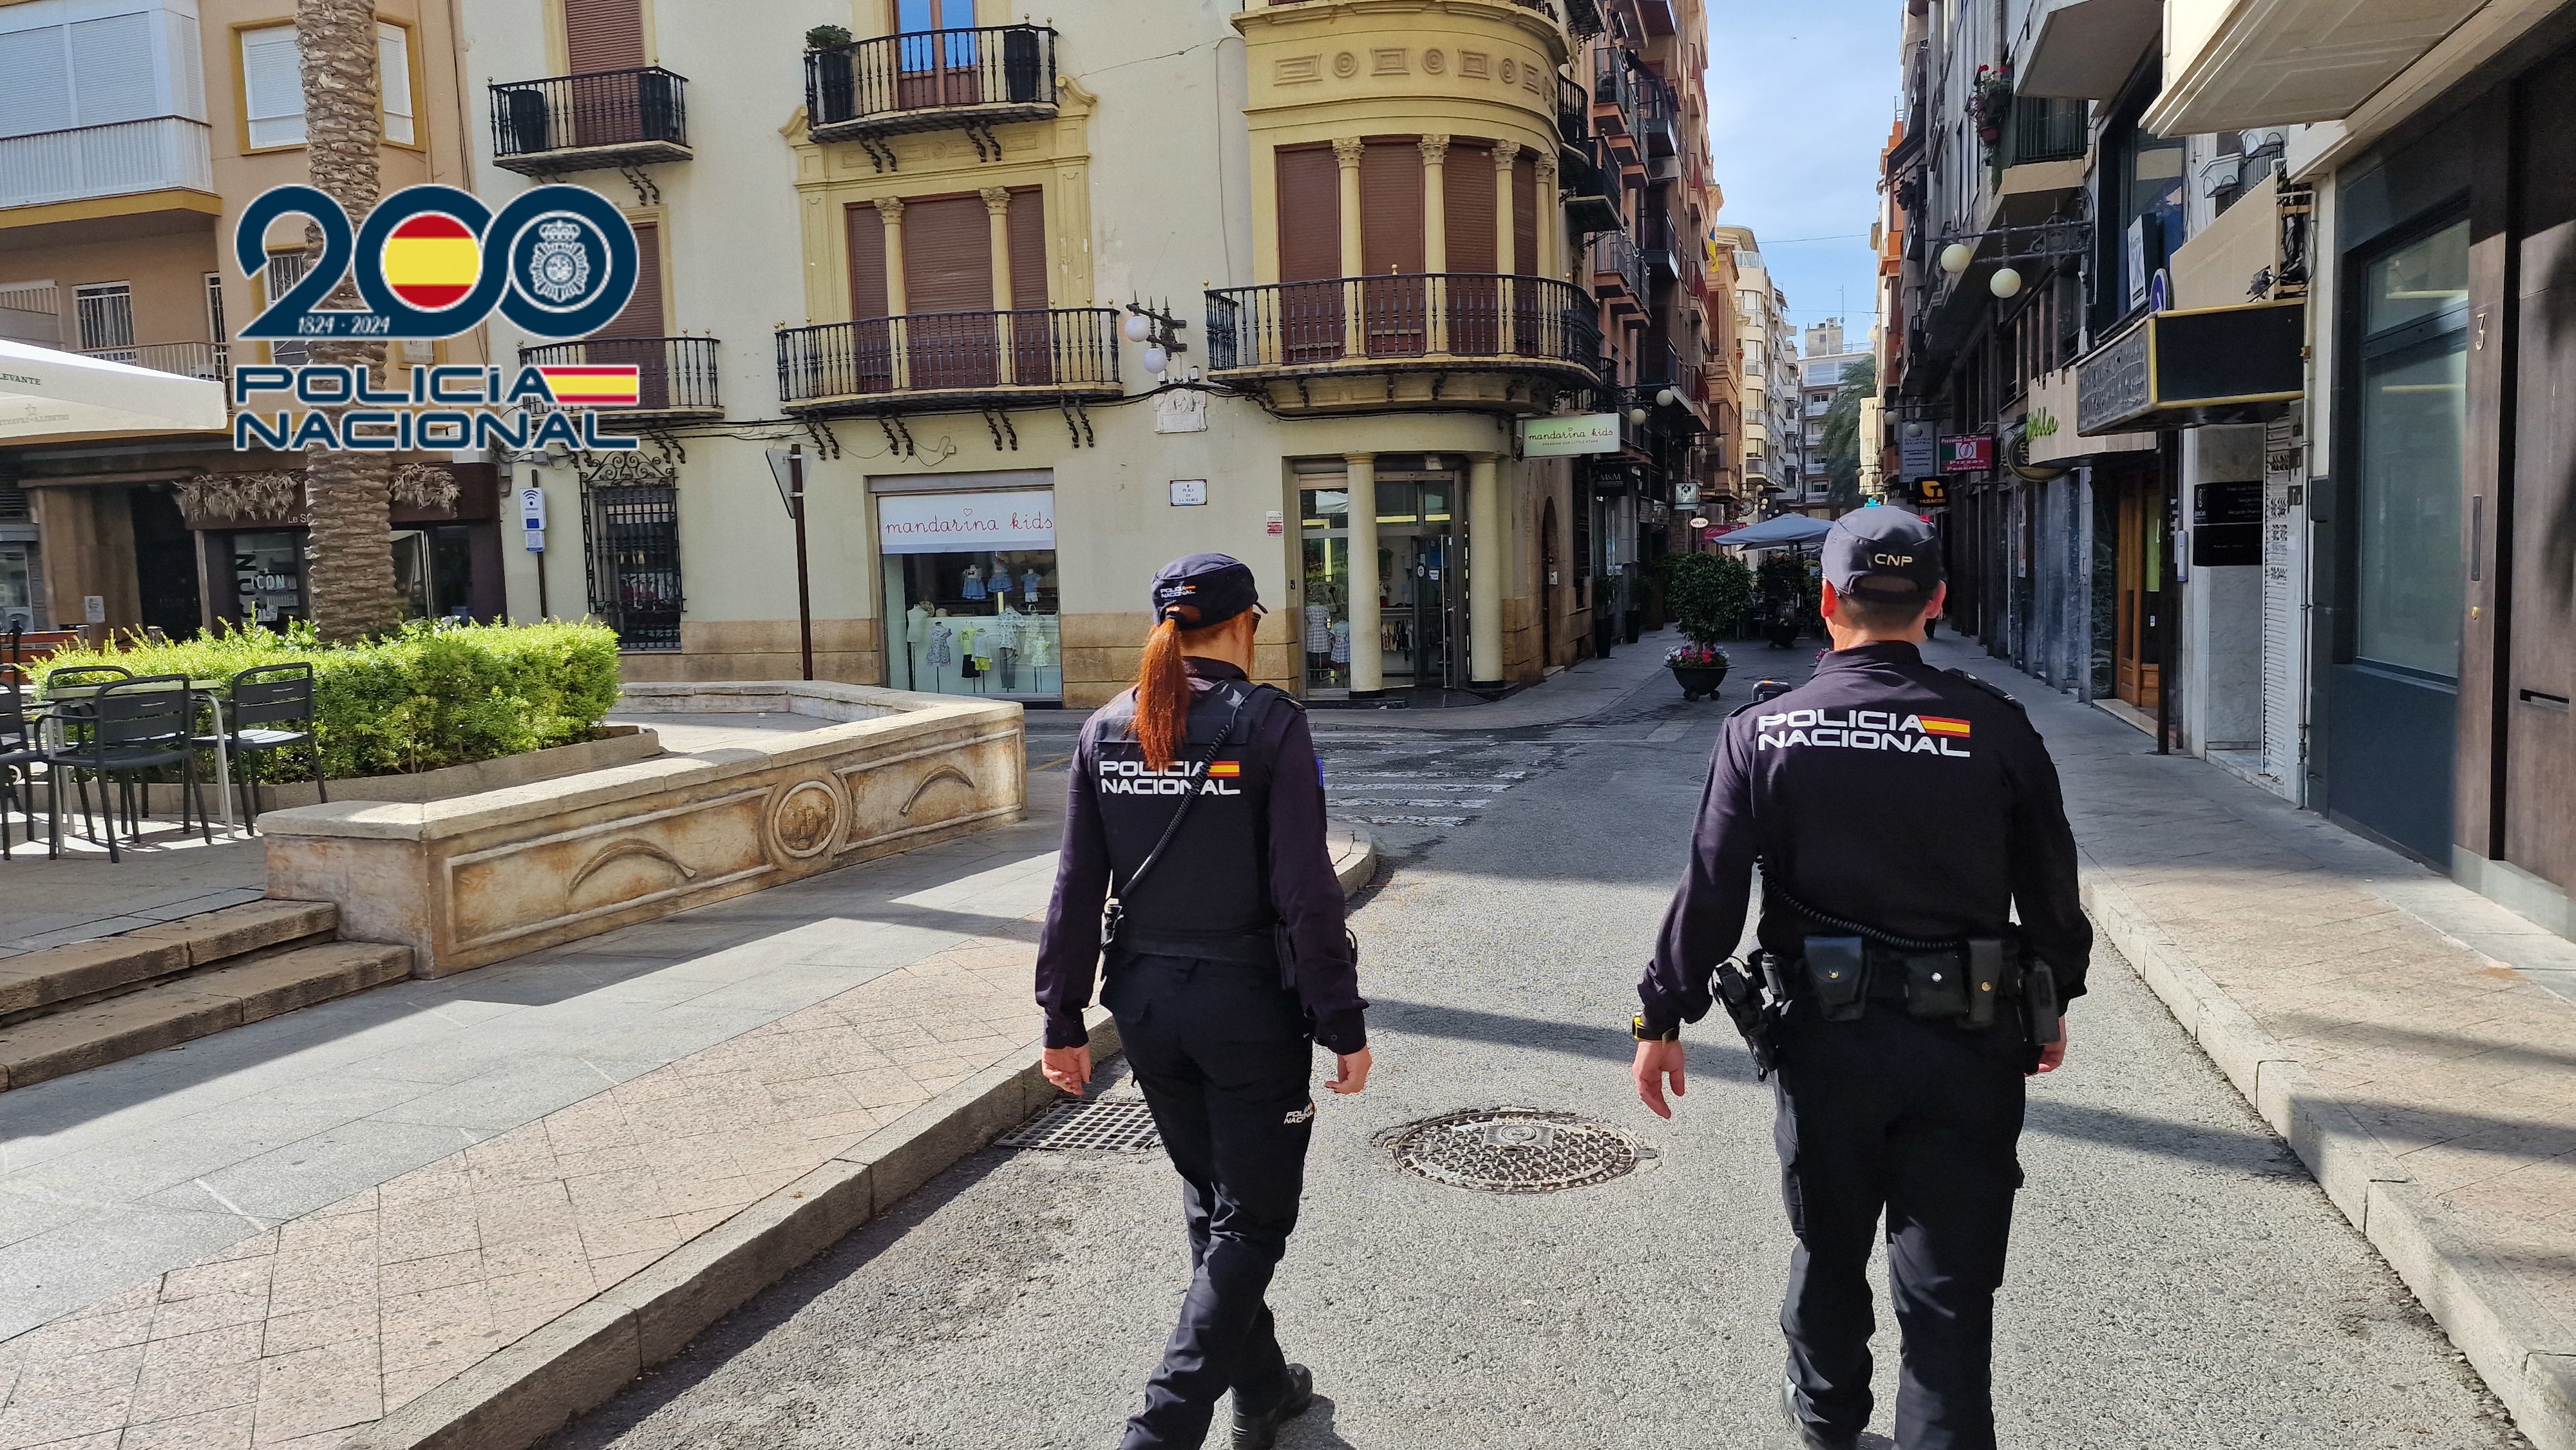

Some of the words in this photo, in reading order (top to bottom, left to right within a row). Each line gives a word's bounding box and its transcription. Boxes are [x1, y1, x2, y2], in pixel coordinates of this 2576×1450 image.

[2476, 313, 2486, 350] 3
[0, 373, 41, 385] EVANTE
[1528, 428, 1586, 440] mandarina
[1591, 428, 1613, 437] kids
[886, 509, 999, 534] mandarina
[1009, 511, 1053, 530] kids
[1875, 553, 1913, 567] CNP
[1758, 728, 1971, 757] NACIONAL
